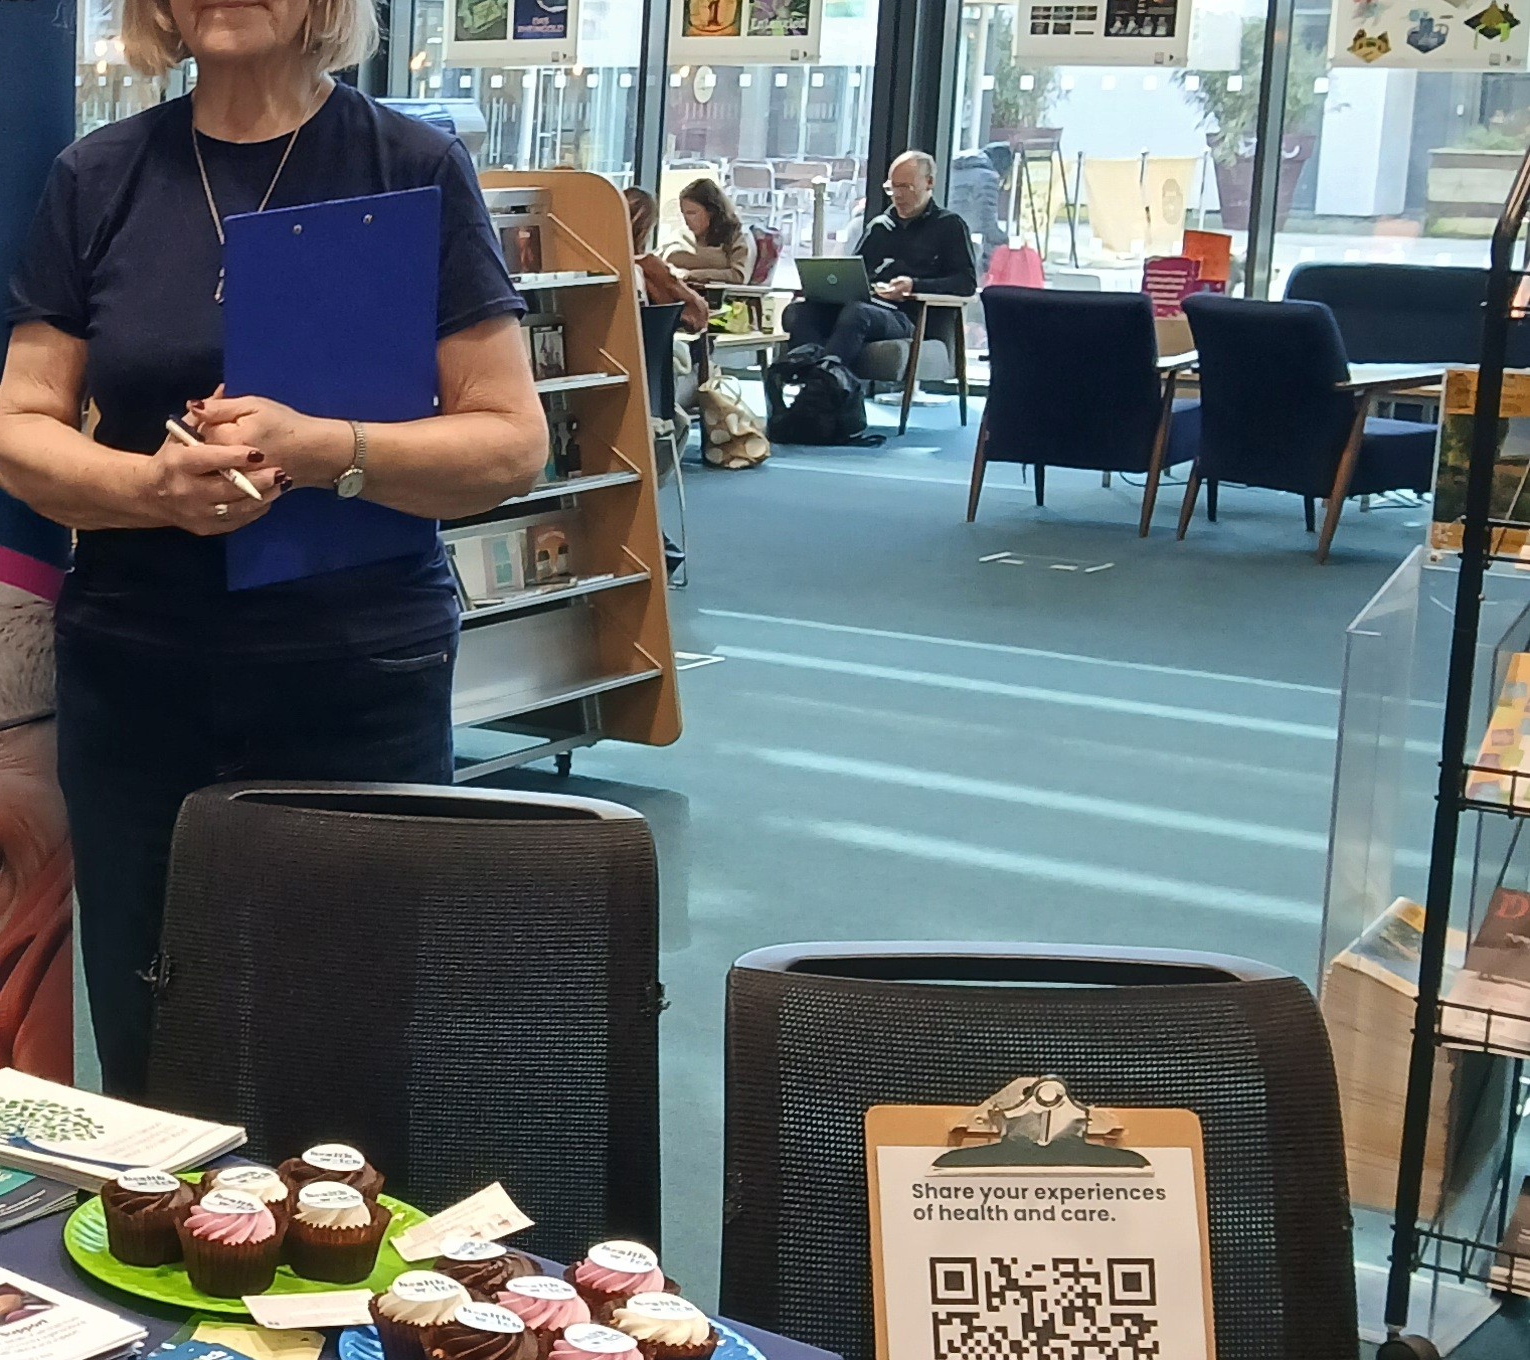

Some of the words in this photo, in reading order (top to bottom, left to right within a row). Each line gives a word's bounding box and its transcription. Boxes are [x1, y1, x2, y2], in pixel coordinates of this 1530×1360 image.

[911, 1182, 974, 1201] Share
[978, 1185, 1030, 1207] your
[1033, 1183, 1167, 1206] experiences
[912, 1203, 935, 1222] of
[938, 1204, 1008, 1223] health
[1013, 1204, 1056, 1223] and
[1061, 1208, 1117, 1223] care.
